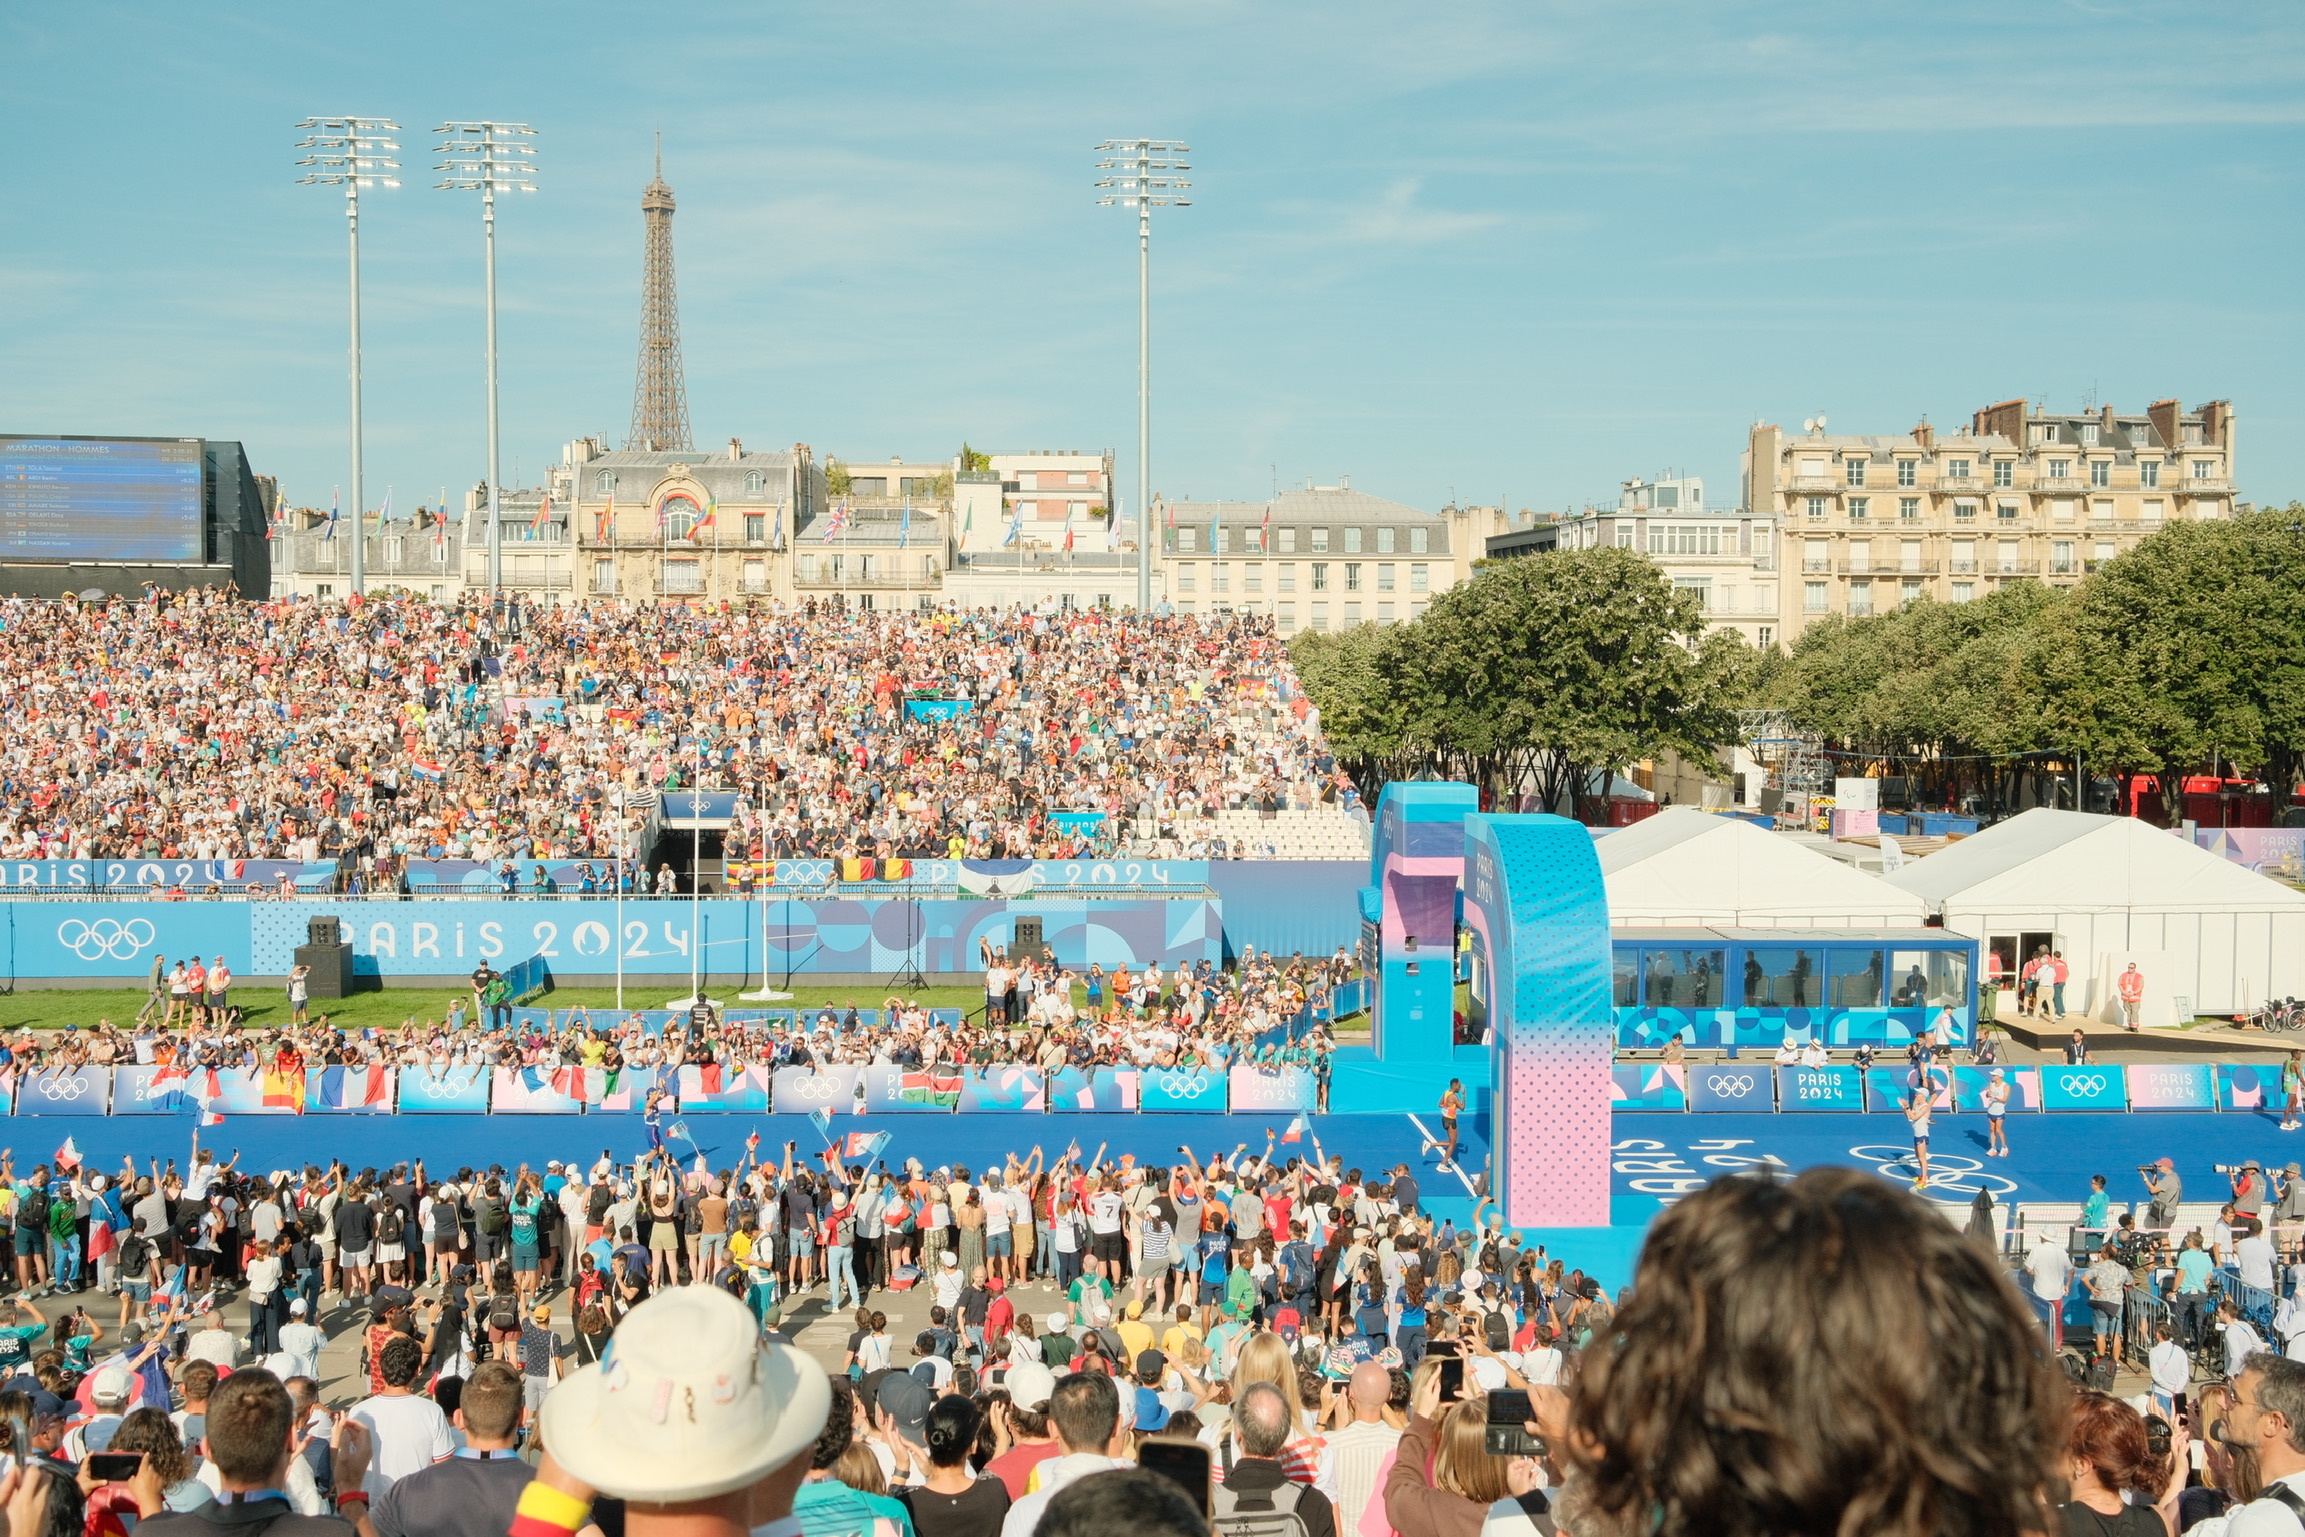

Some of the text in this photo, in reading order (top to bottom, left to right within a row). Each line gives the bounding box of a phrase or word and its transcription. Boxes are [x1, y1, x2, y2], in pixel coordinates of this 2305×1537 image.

[6, 444, 60, 452] MARATHON
[68, 446, 110, 454] HOMMES
[2260, 836, 2297, 846] PARIS
[2260, 848, 2288, 859] 202
[1065, 863, 1168, 886] 2024
[533, 920, 688, 957] 2024
[1252, 1076, 1296, 1088] PARIS
[1798, 1074, 1842, 1086] PARIS
[2150, 1074, 2193, 1085] PARIS
[1253, 1089, 1296, 1100] 2024
[1800, 1088, 1842, 1099] 2024
[2152, 1087, 2194, 1098] 2024
[1611, 1139, 1706, 1209] ARIS
[1106, 1206, 1113, 1218] 7
